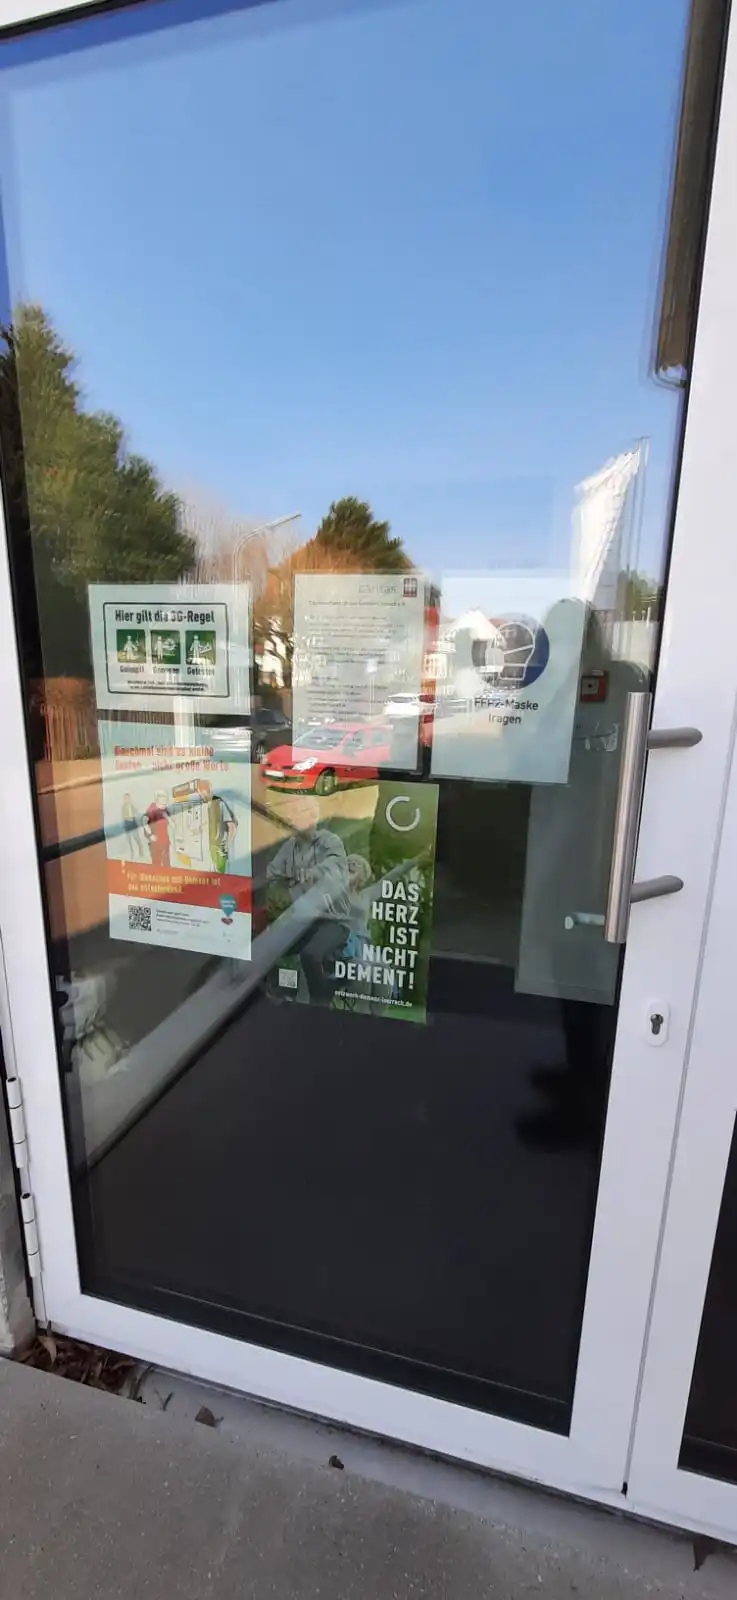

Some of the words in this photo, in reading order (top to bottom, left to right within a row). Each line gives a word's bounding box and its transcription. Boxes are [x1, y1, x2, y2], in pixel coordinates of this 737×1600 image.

[115, 610, 134, 622] Hier
[136, 610, 152, 624] gilt
[154, 611, 168, 622] die
[170, 611, 215, 624] 3G-Regel
[381, 879, 420, 901] DAS
[372, 901, 419, 925] HERZ
[389, 926, 419, 945] IST
[362, 943, 418, 969] NICHT
[334, 960, 415, 989] DEMENT!
